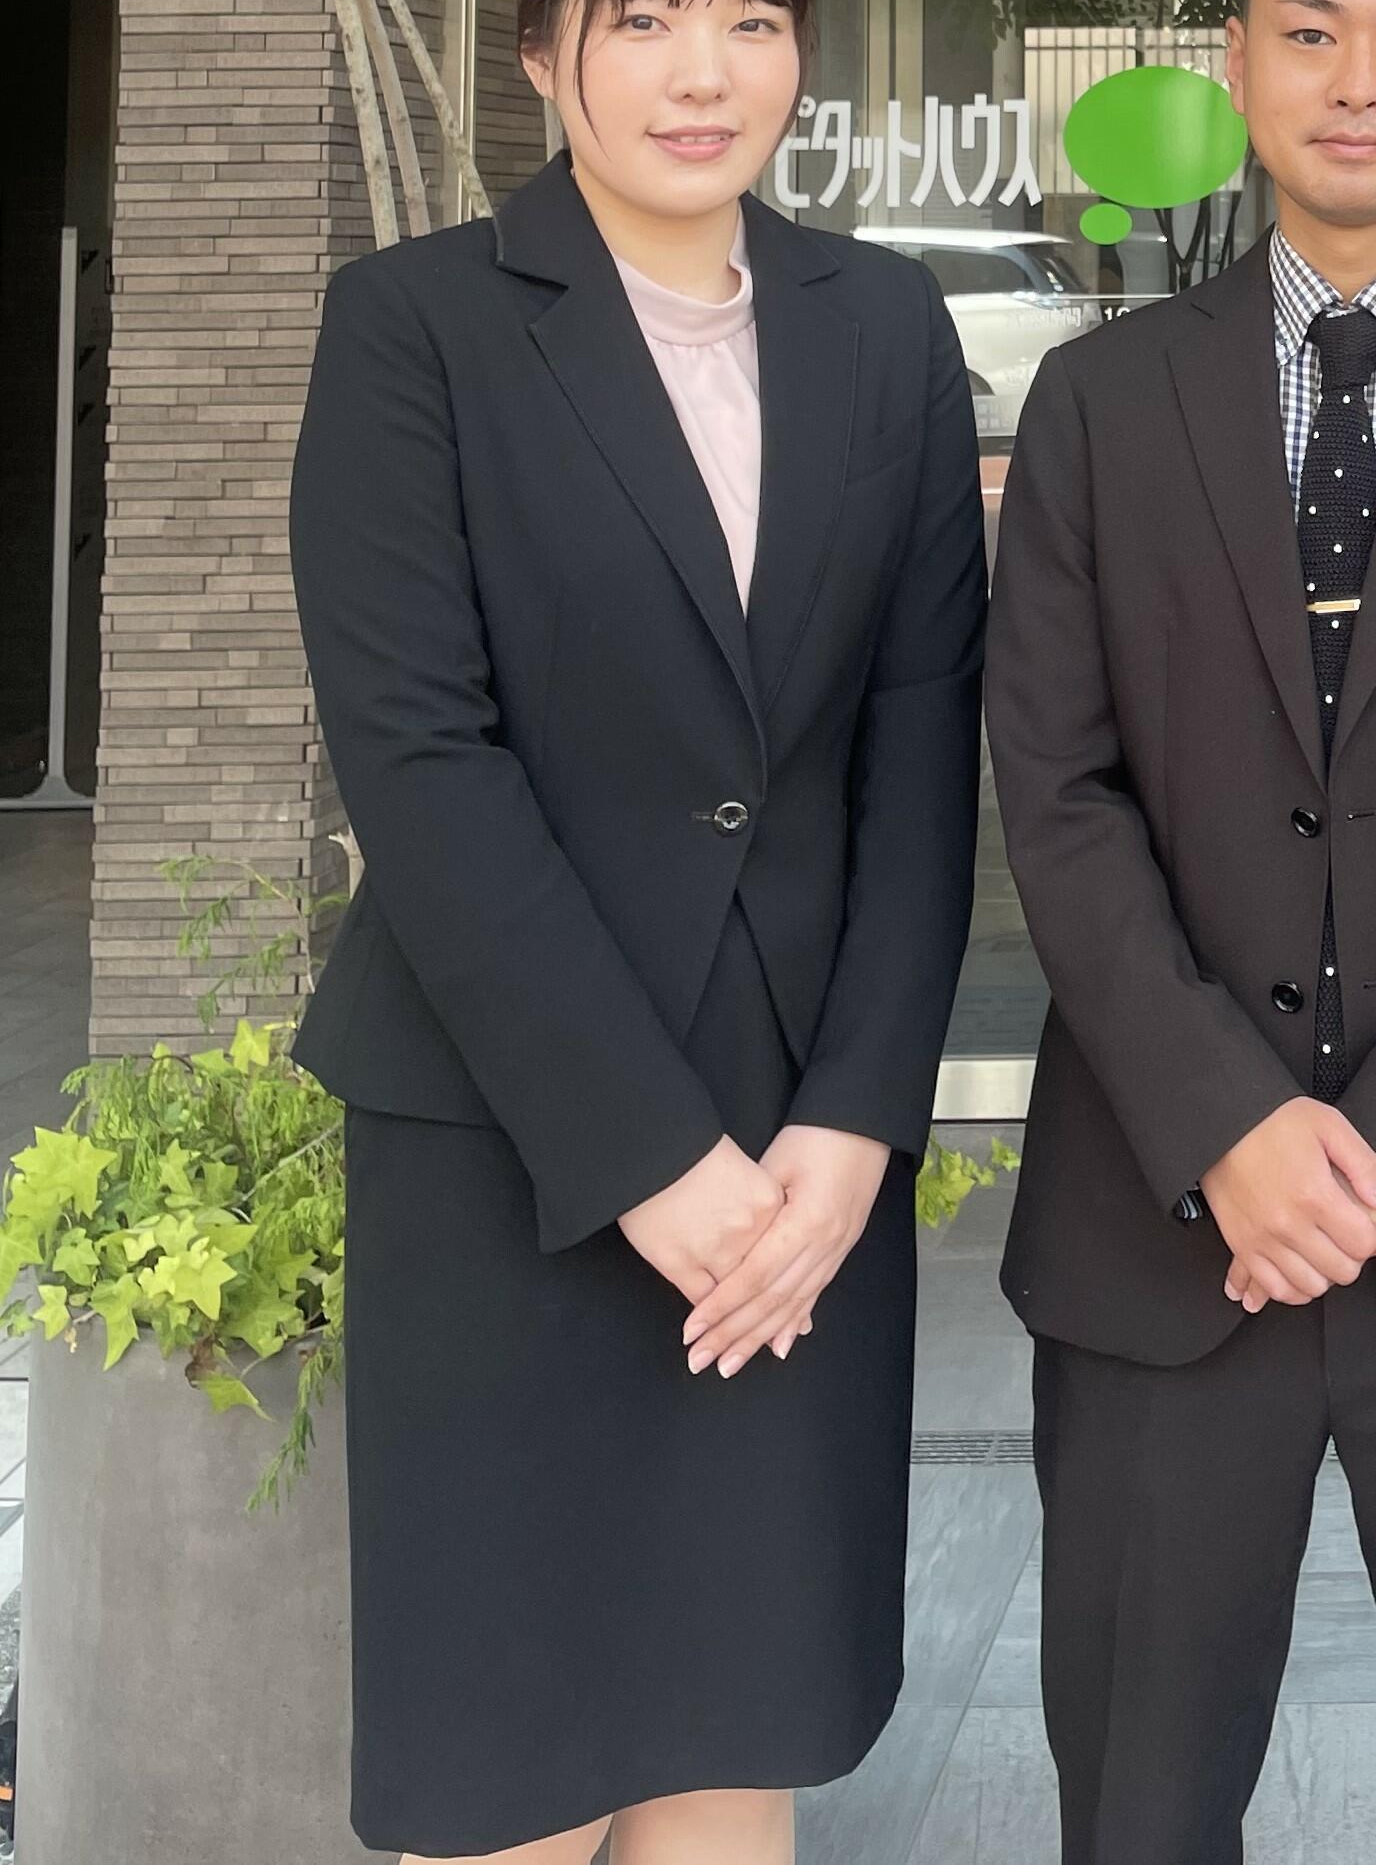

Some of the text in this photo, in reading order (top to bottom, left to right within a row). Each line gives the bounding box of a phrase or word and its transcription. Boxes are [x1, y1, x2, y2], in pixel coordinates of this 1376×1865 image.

[774, 93, 1042, 209] ピタットハウス
